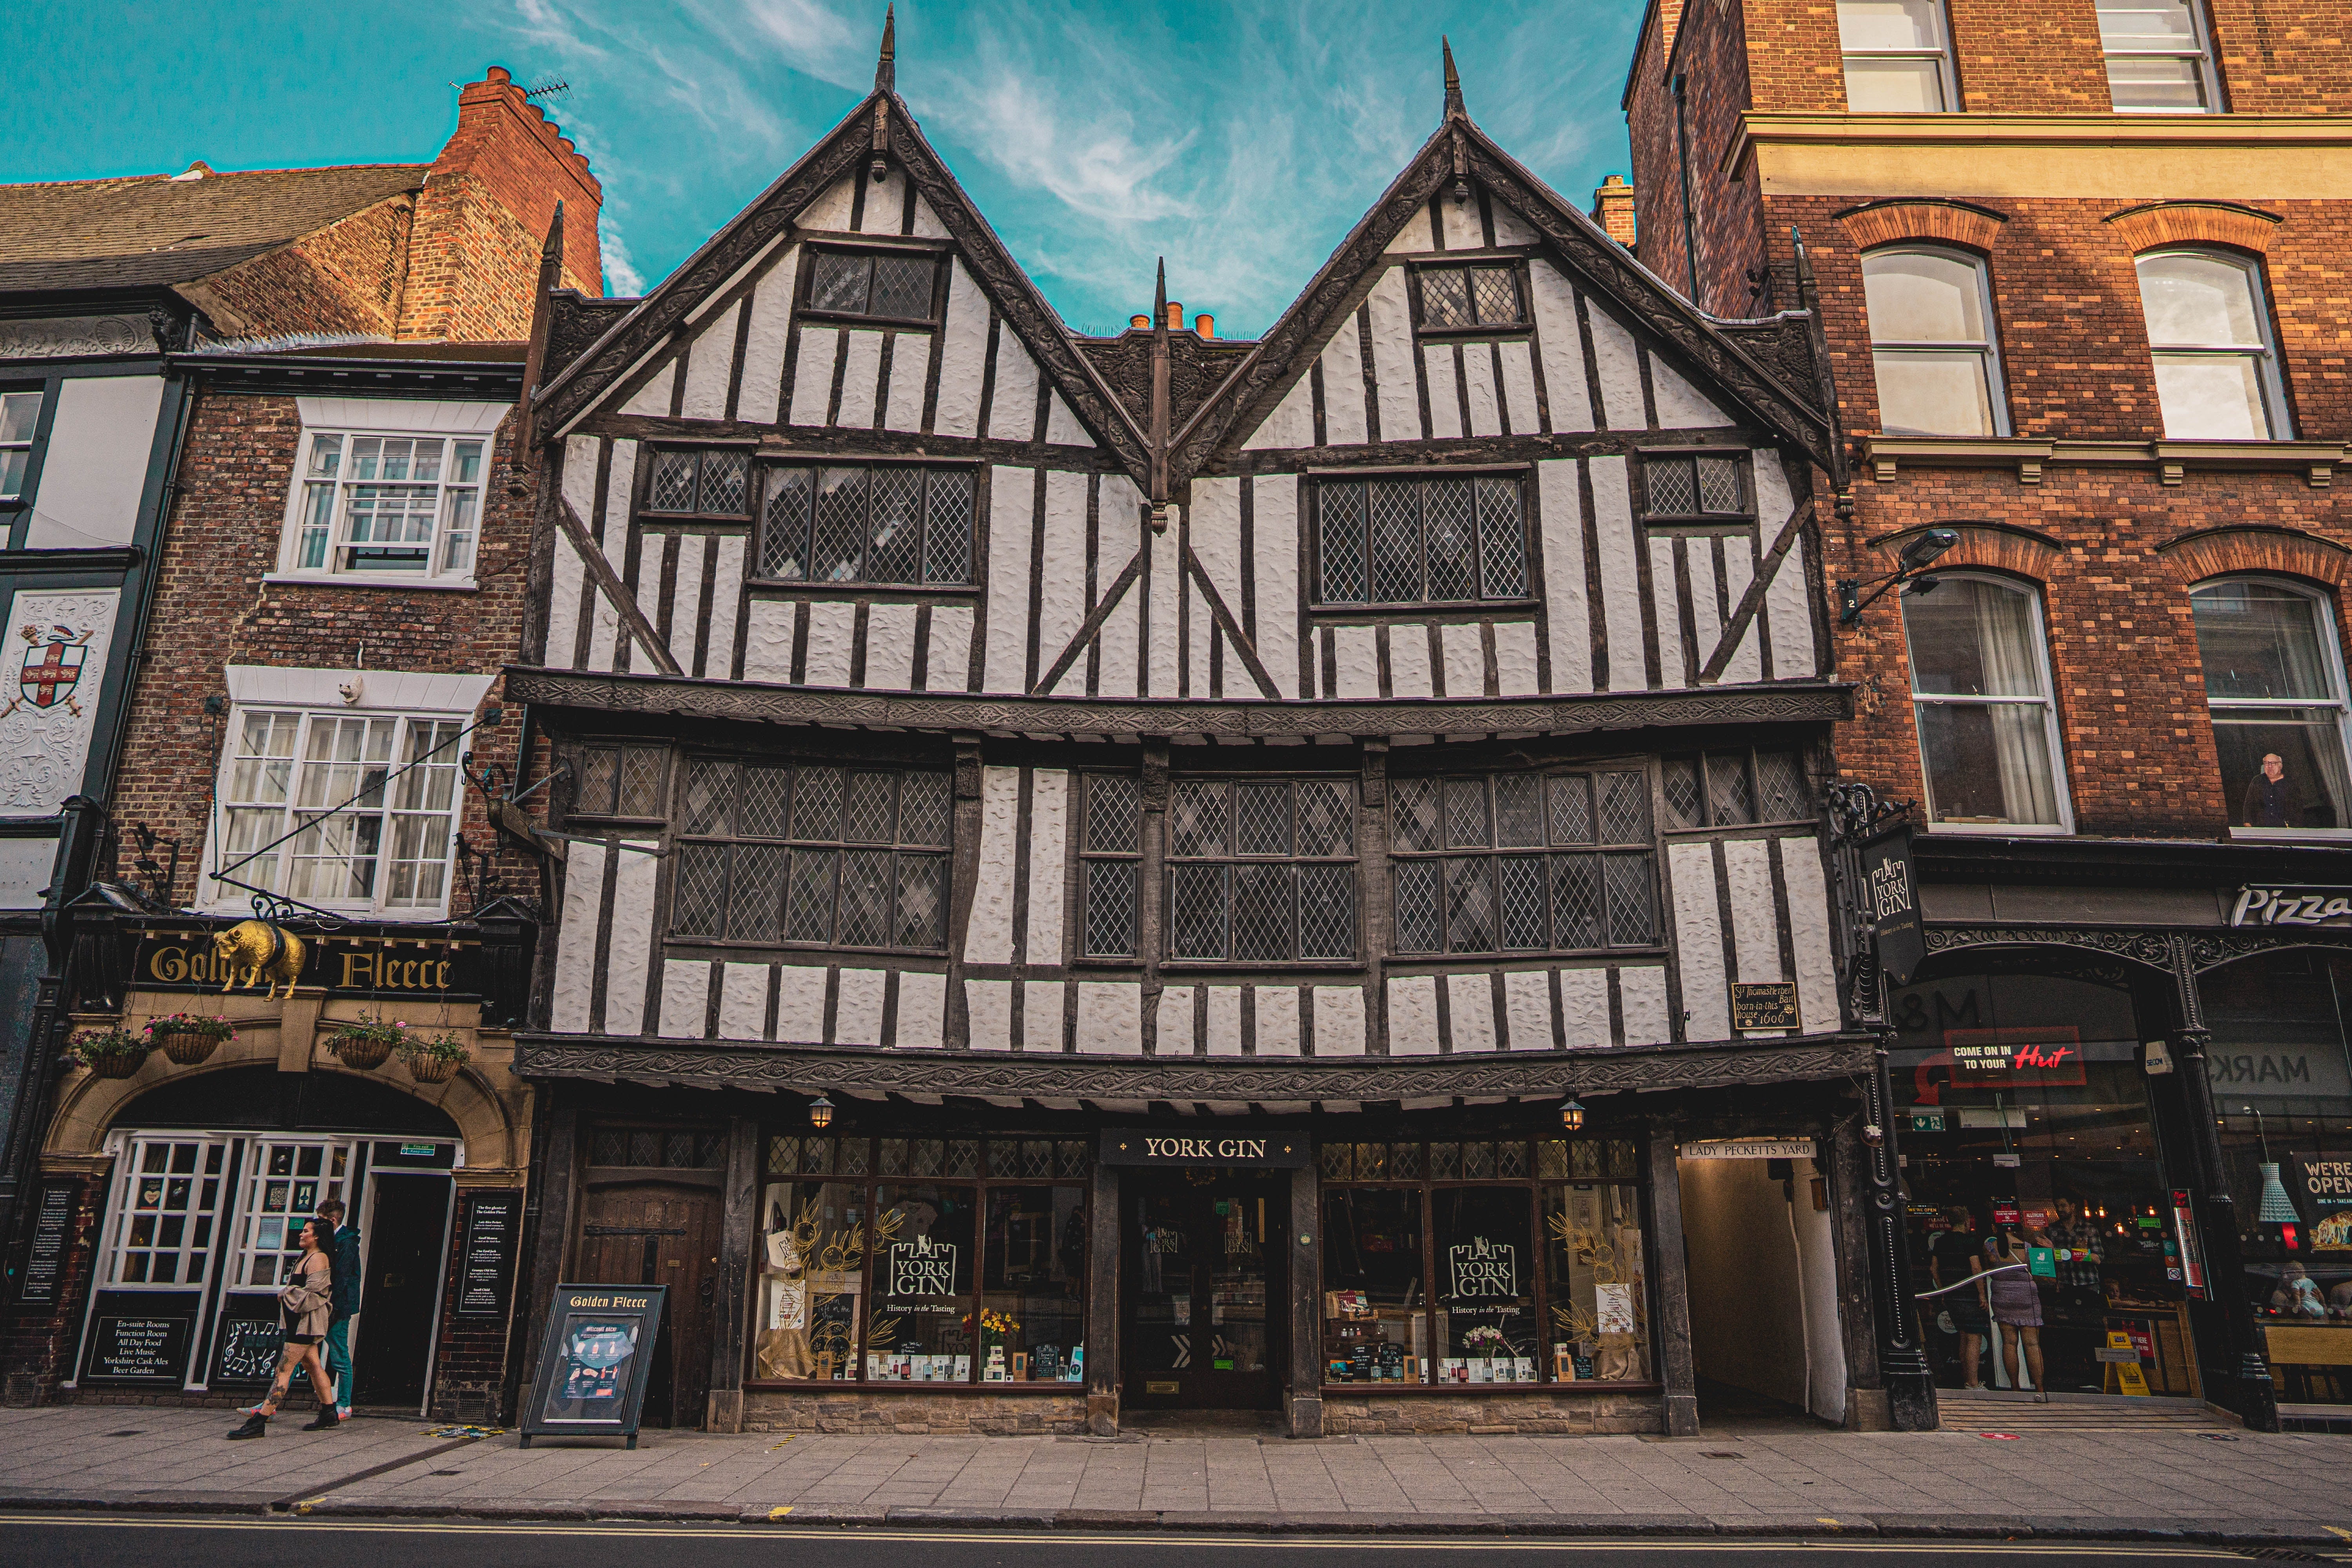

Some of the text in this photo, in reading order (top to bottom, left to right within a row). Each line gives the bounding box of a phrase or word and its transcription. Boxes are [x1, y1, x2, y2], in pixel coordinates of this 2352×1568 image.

[1877, 878, 1906, 899] YORK
[1880, 891, 1906, 916] GIN
[2232, 889, 2352, 926] Pizza
[1880, 928, 1892, 936] History
[151, 947, 451, 989] Gol Fleece
[1747, 986, 1770, 998] Thomas
[1737, 1010, 1785, 1024] house 1606
[1954, 1044, 2074, 1069] COME ON IN Hut
[2147, 1058, 2163, 1066] SECOM
[1964, 1060, 2006, 1069] TO YOUR
[1145, 1138, 1266, 1157] YORK GIN
[1689, 1145, 1809, 1156] LADY PECKETT'S YARD
[2305, 1162, 2352, 1176] WE'RE
[1153, 1245, 1174, 1253] GIN
[897, 1261, 950, 1276] YORK
[1456, 1263, 1511, 1277] YORK
[897, 1276, 948, 1295] GIN
[1459, 1276, 1509, 1296] GIN
[570, 1296, 647, 1307] Golden Fleece
[887, 1305, 912, 1314] History
[931, 1305, 955, 1314] Tasting
[1452, 1306, 1477, 1315] History
[1495, 1306, 1520, 1315] Tasting
[129, 1339, 143, 1348] Day
